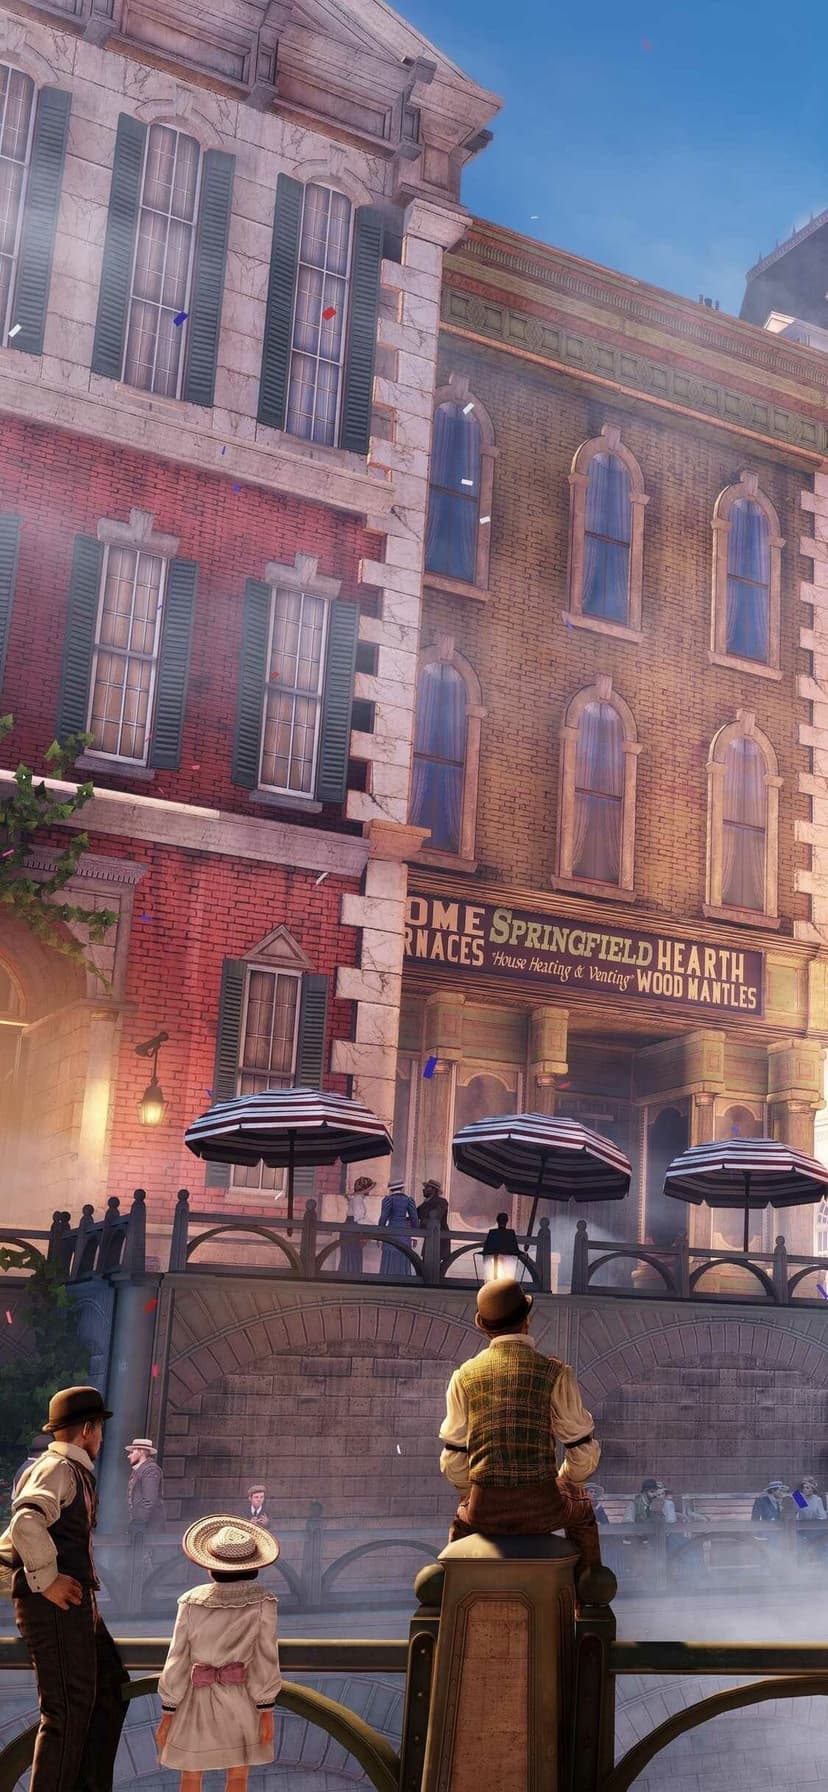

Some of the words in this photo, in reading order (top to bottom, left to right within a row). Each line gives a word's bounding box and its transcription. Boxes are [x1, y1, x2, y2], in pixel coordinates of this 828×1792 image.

[490, 908, 653, 966] SPRINGFIELD
[529, 957, 572, 982] Heating
[574, 964, 585, 978] &
[657, 939, 744, 983] HEARTH
[637, 968, 683, 998] WOOD
[688, 977, 757, 1009] MANTLES
